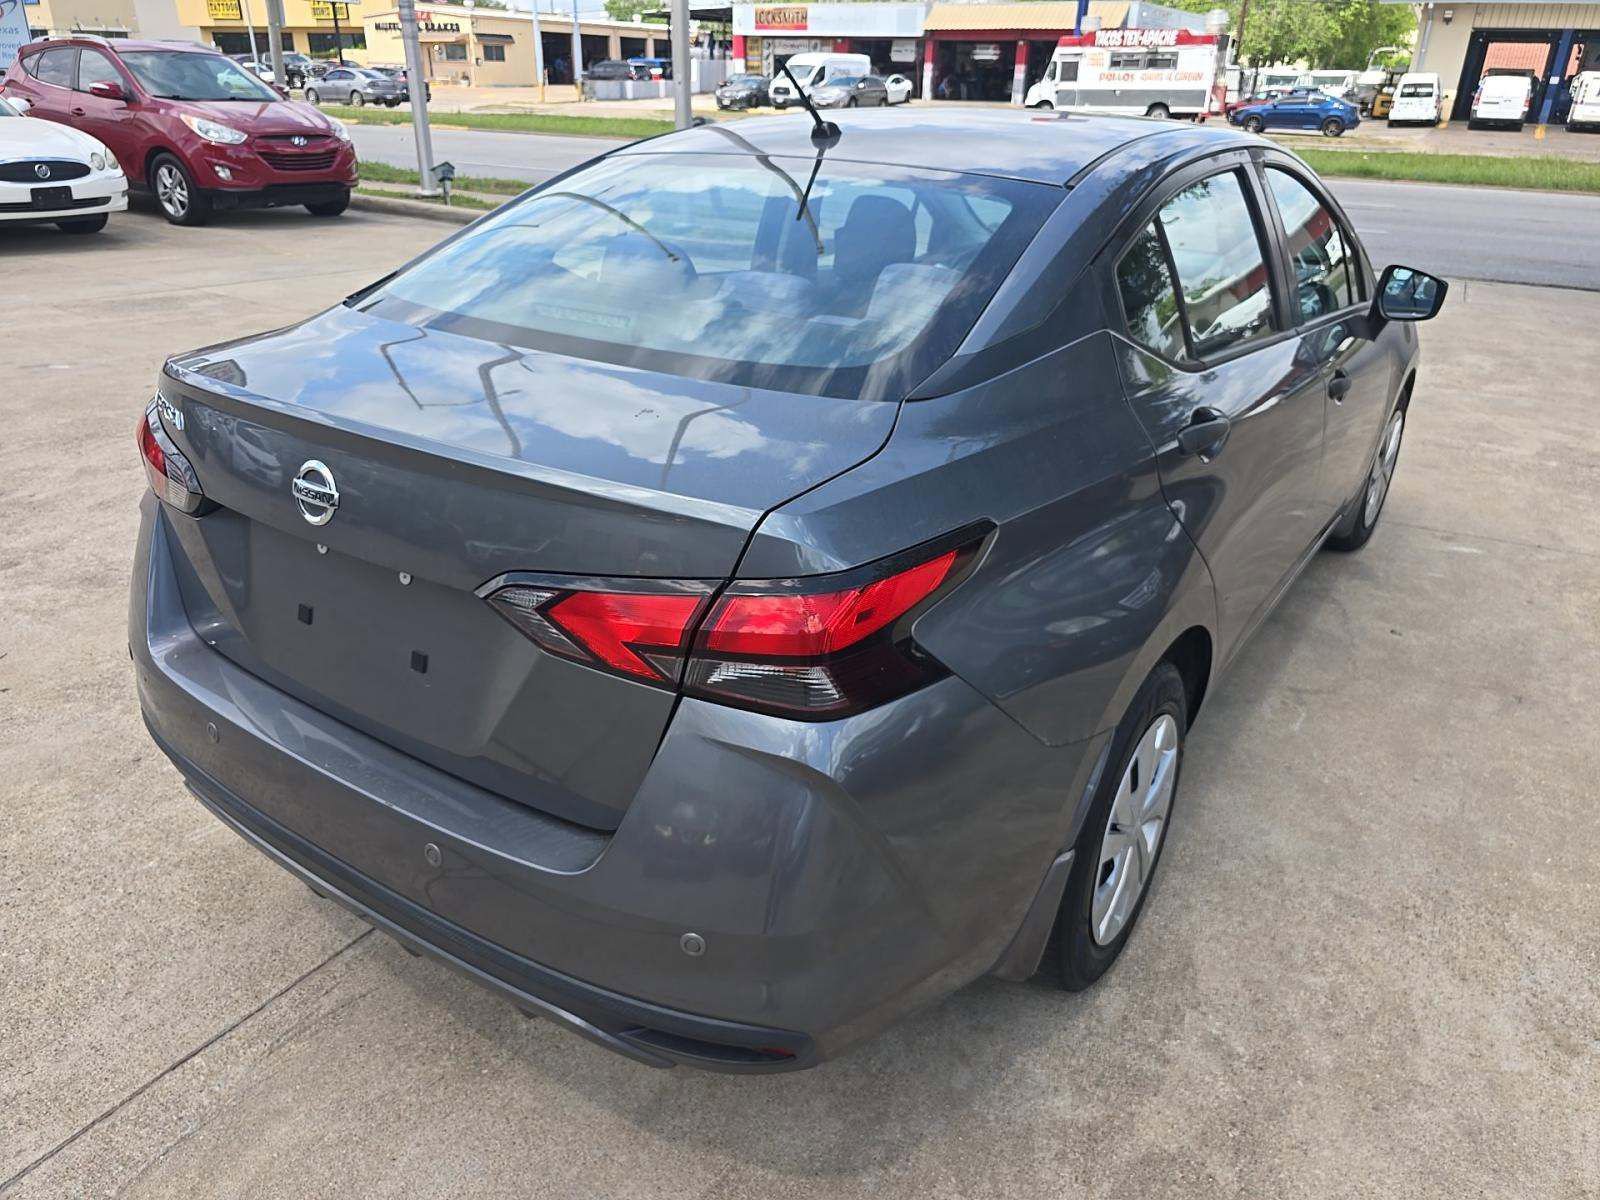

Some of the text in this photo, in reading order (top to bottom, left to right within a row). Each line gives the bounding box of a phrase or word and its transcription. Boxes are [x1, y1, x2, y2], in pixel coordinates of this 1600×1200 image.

[755, 8, 808, 24] LOCKSMITH
[424, 22, 461, 32] BRAKES
[1095, 29, 1123, 46] TACOS
[1099, 72, 1136, 81] POLLOS
[294, 481, 335, 505] NISSAN
